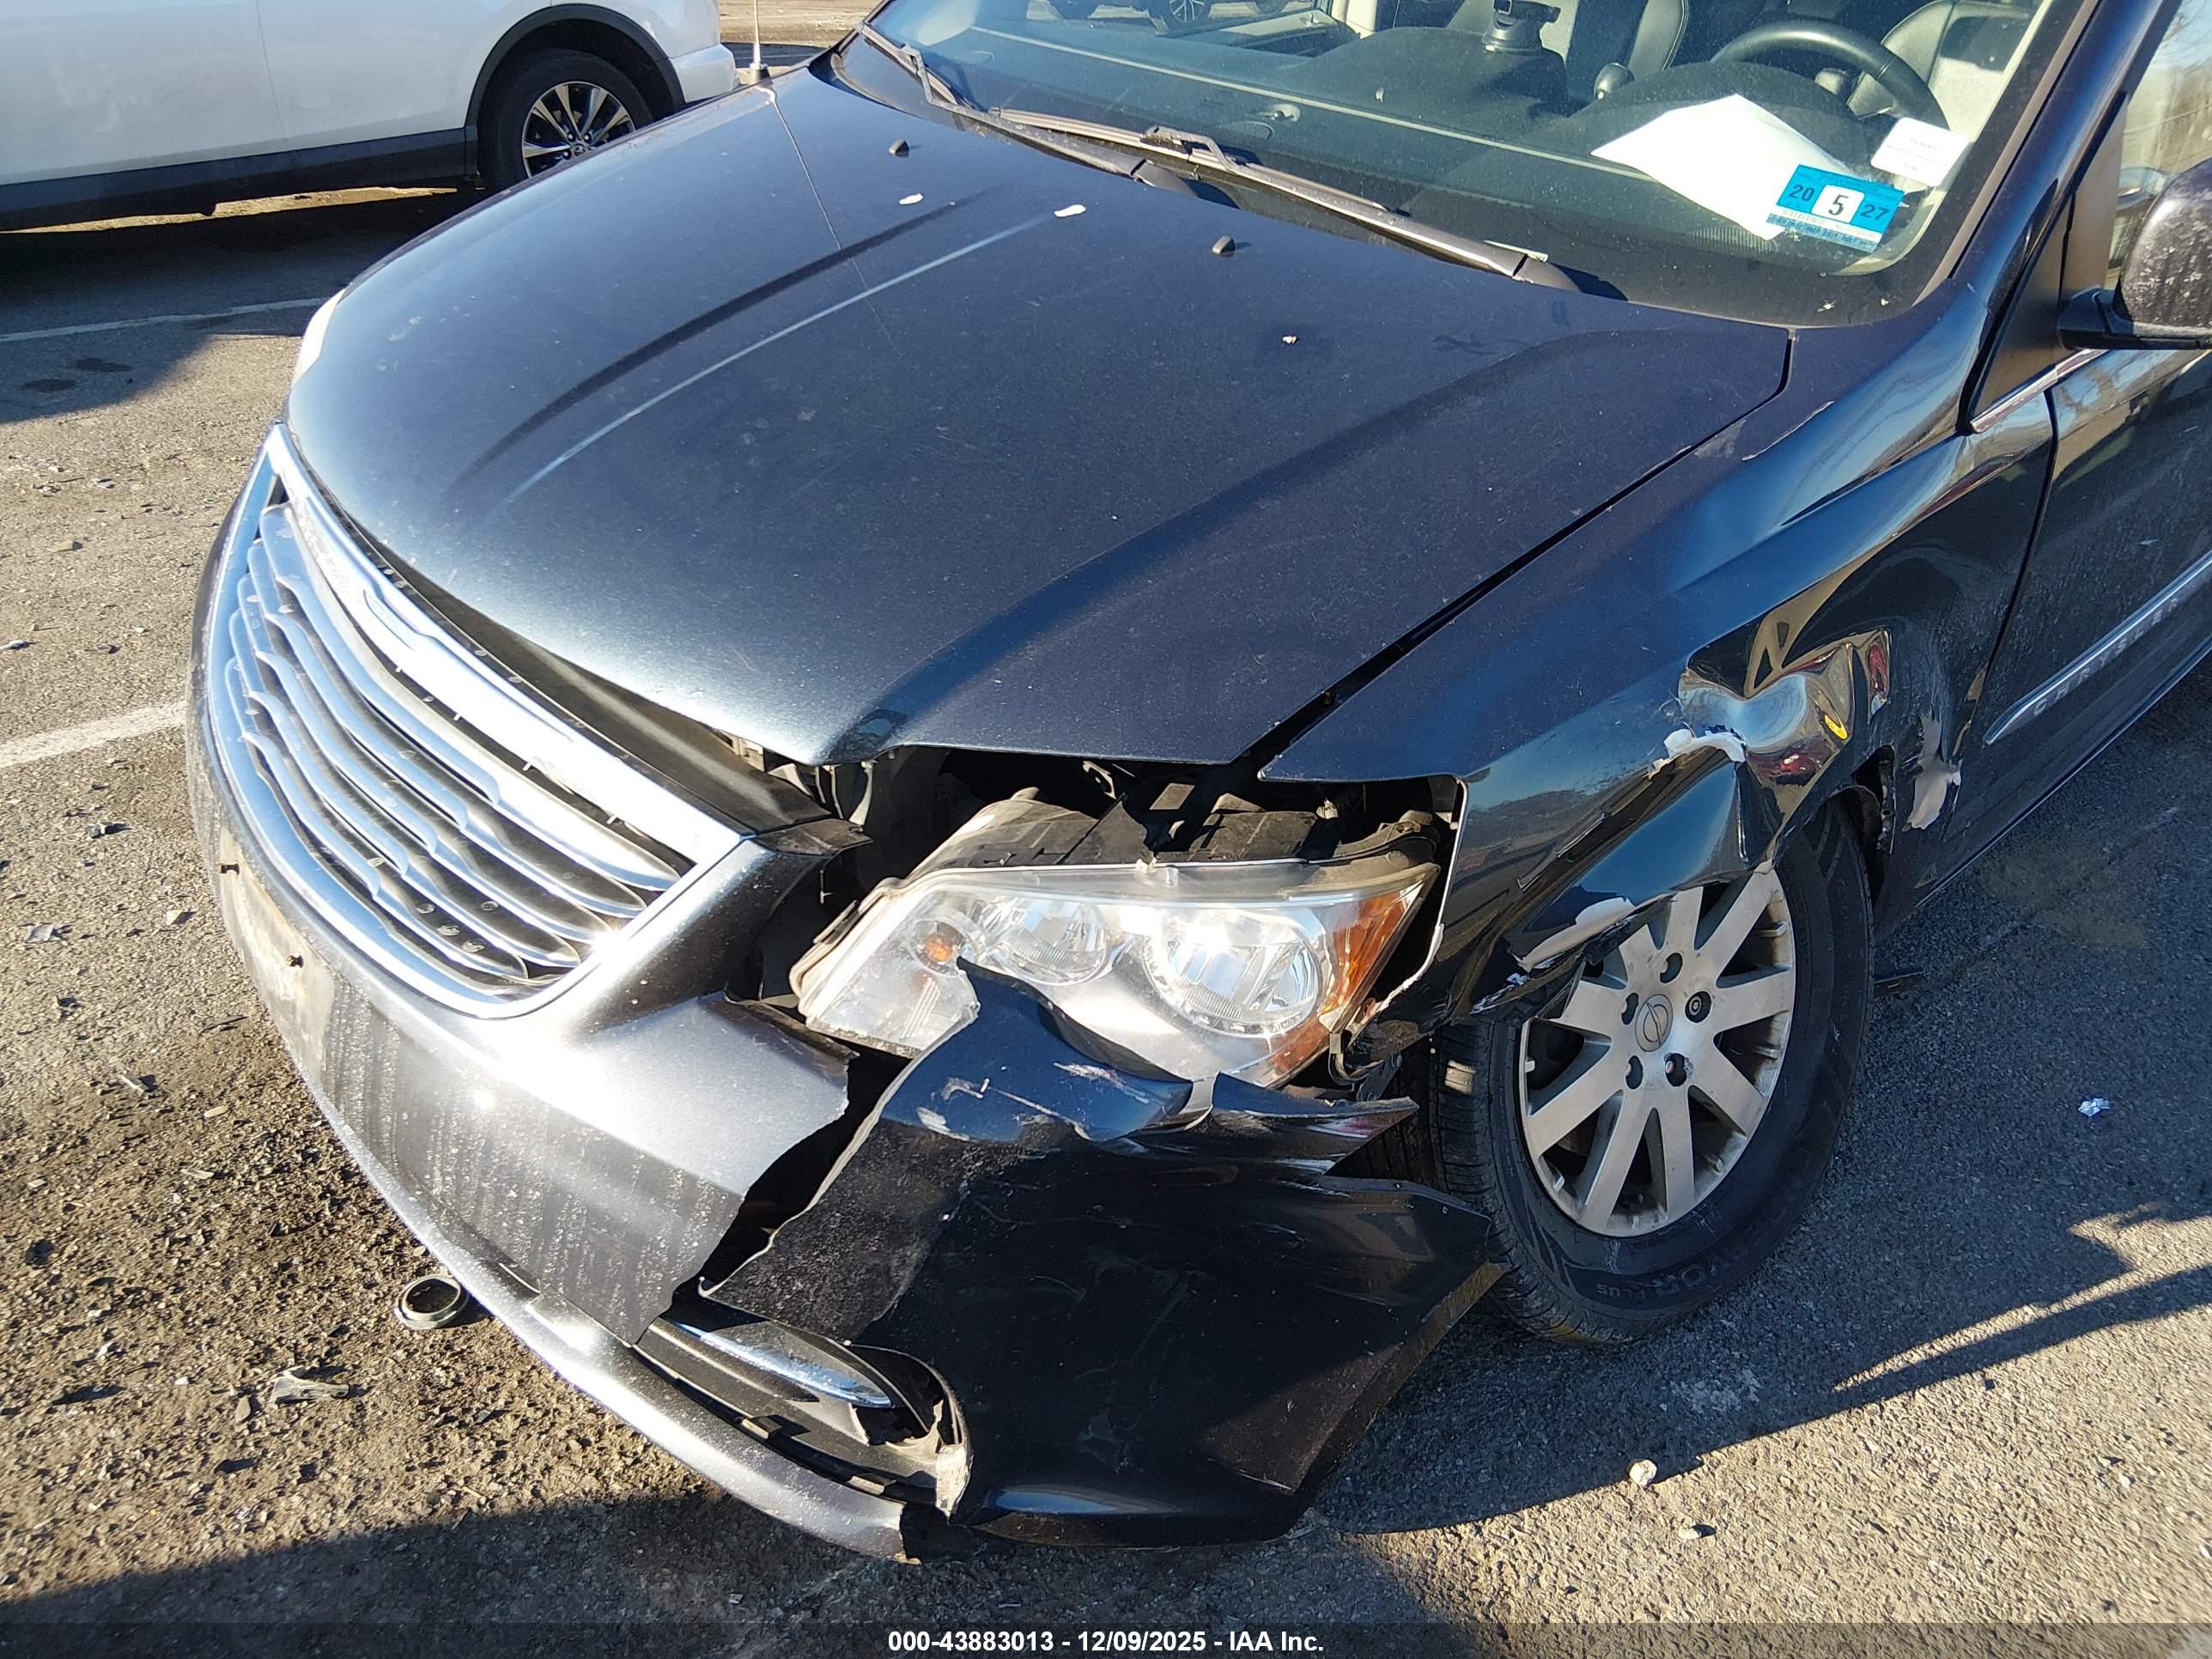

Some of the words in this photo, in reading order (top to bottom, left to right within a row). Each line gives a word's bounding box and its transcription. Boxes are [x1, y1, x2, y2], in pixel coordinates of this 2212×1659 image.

[1789, 184, 1815, 202] 20
[1828, 194, 1849, 216] 5
[1861, 204, 1889, 221] 27
[2033, 597, 2179, 717] CHRYSLER
[1596, 1284, 1647, 1299] PLUS
